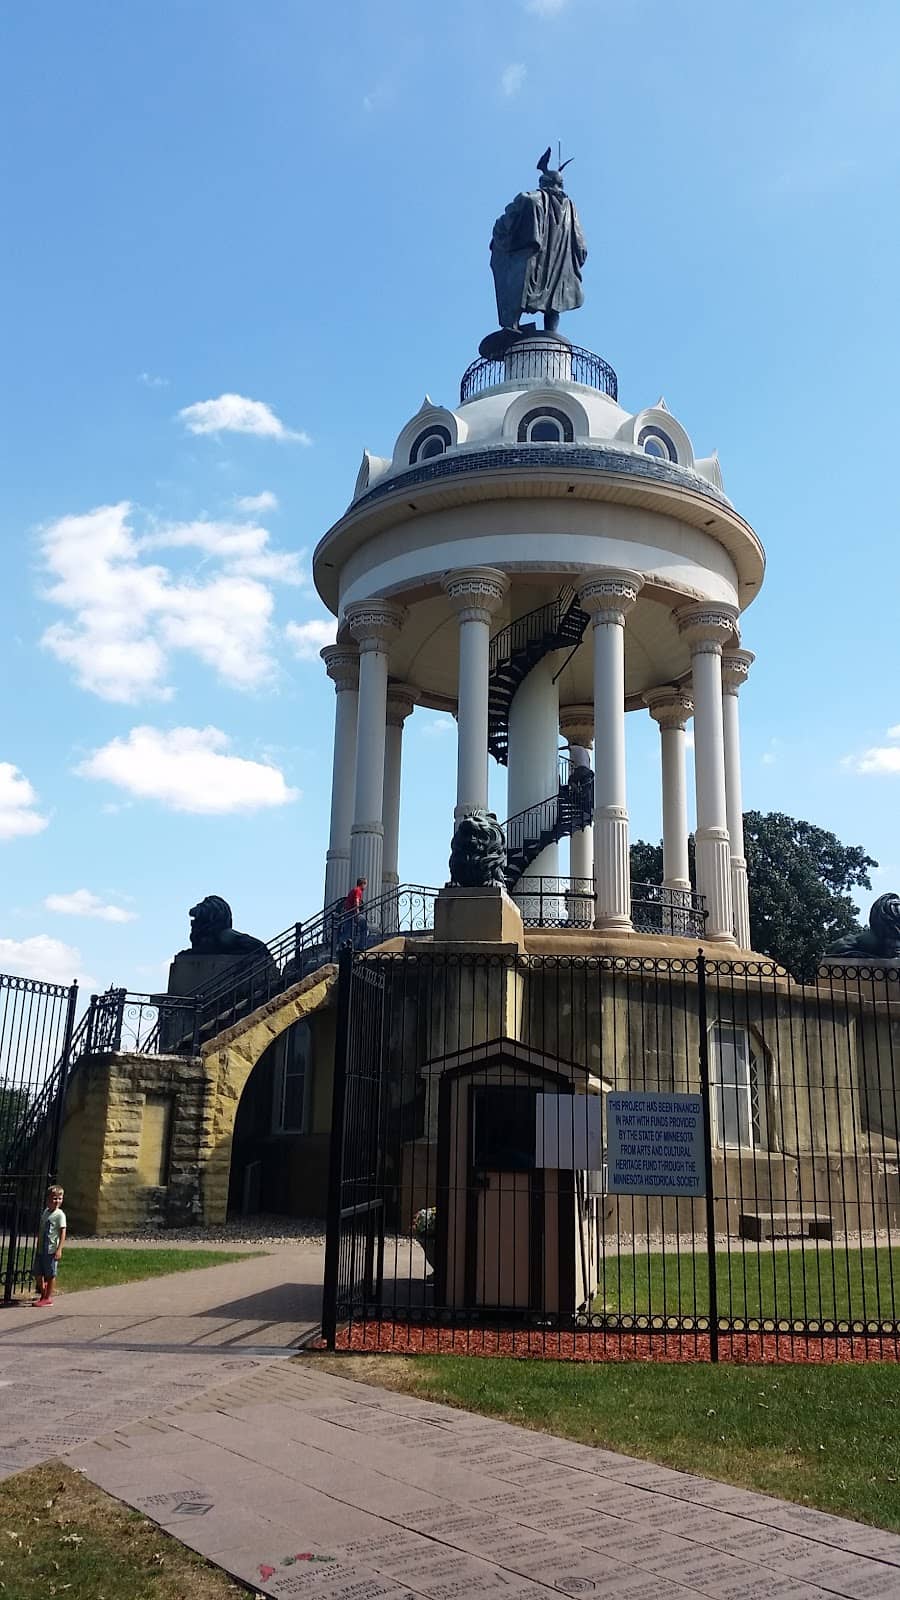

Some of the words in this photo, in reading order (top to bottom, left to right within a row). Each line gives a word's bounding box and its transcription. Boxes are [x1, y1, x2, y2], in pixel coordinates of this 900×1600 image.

[609, 1101, 620, 1111] THIS
[621, 1101, 645, 1112] PROJECT
[646, 1101, 657, 1112] HAS
[659, 1102, 672, 1112] BEEN
[673, 1103, 700, 1113] FINANCED
[616, 1115, 621, 1126] IN
[623, 1115, 635, 1126] PART
[637, 1116, 649, 1126] WITH
[651, 1116, 668, 1127] FUNDS
[670, 1116, 696, 1128] PROVIDED
[619, 1130, 626, 1140] BY
[626, 1130, 638, 1140] THE
[639, 1130, 654, 1141] STATE
[655, 1131, 663, 1141] OF
[664, 1131, 694, 1142] MINNESOTA
[621, 1144, 636, 1155] FROM
[636, 1145, 651, 1156] ARTS
[651, 1145, 663, 1156] AND
[664, 1146, 691, 1157] CULTURAL
[615, 1159, 641, 1169] HERITAGE
[642, 1160, 657, 1170] FUND
[658, 1160, 684, 1171] THROUGH
[685, 1161, 696, 1172] THE
[613, 1174, 643, 1184] MINNESOTA
[644, 1175, 675, 1186] HISTORICAL
[677, 1175, 700, 1187] SOCIETY
